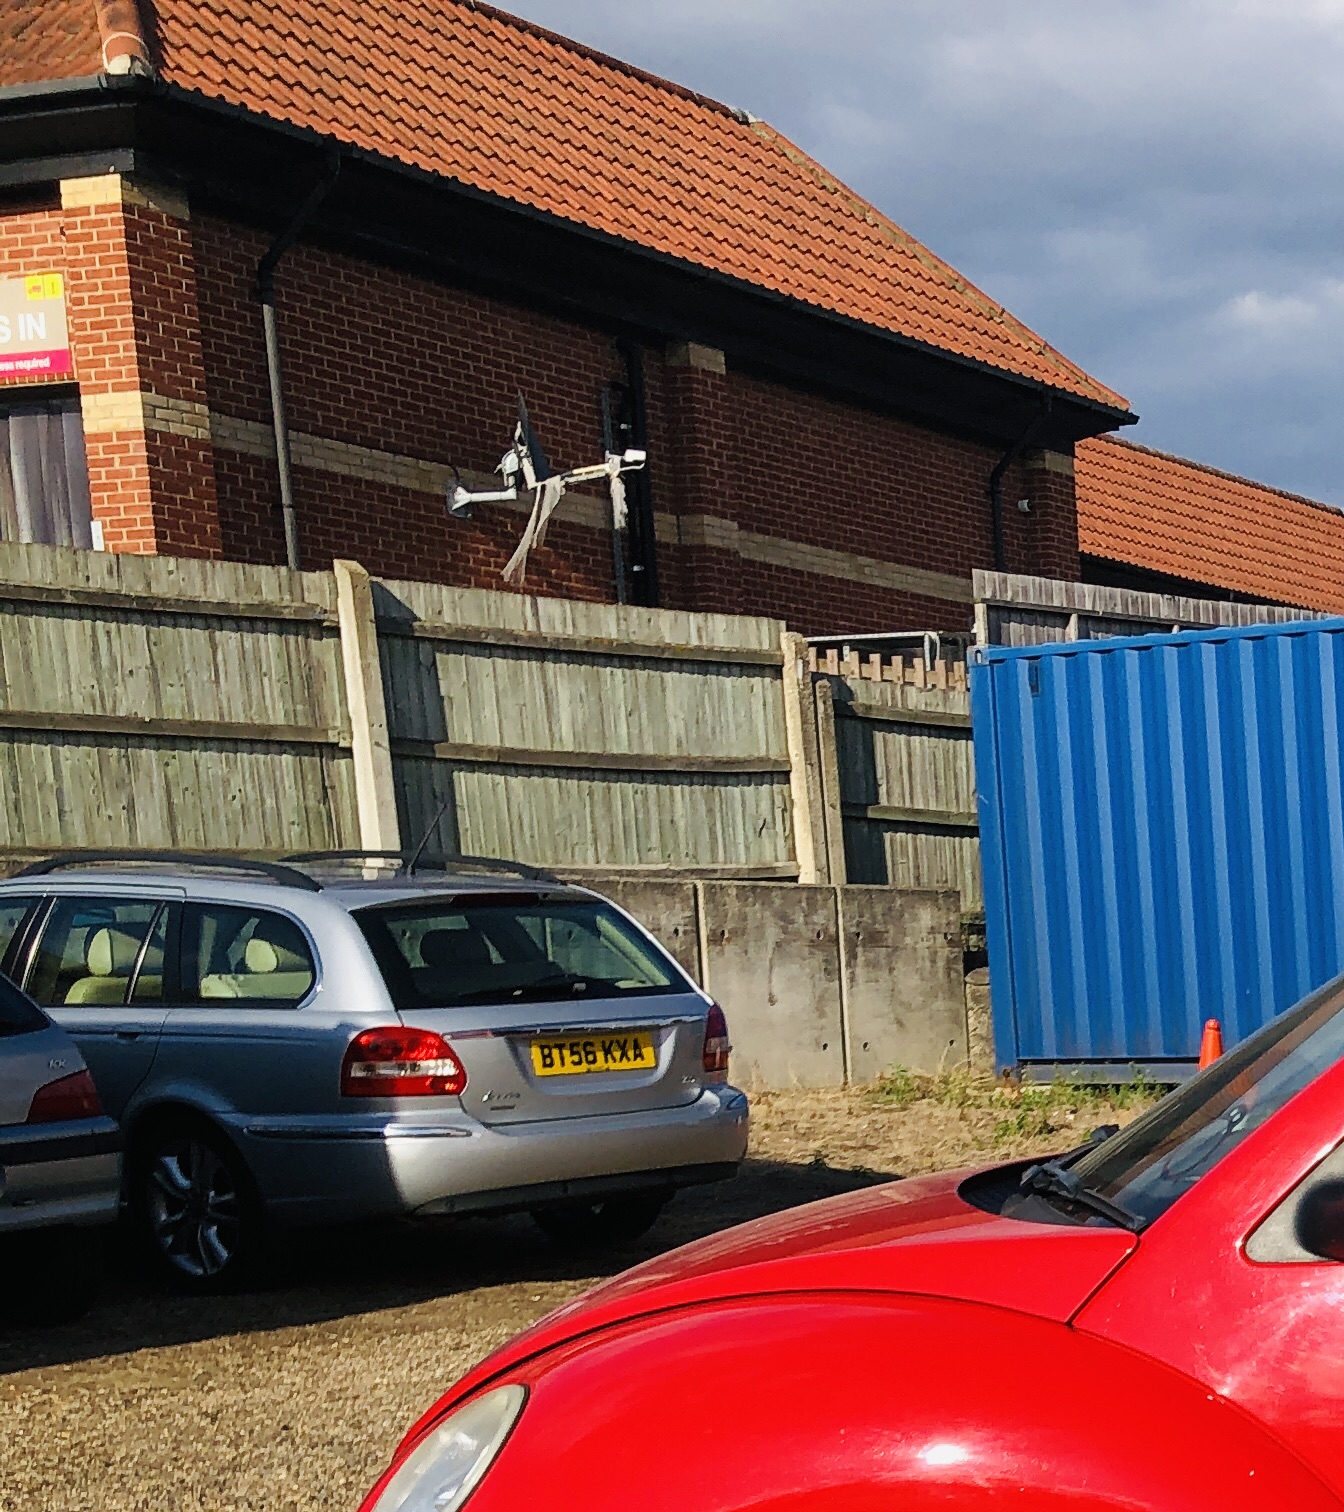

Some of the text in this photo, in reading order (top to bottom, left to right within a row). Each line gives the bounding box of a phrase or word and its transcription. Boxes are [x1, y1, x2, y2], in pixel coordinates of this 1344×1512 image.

[17, 311, 46, 341] IN
[15, 356, 51, 371] required
[540, 1037, 645, 1069] BT56 KXA
